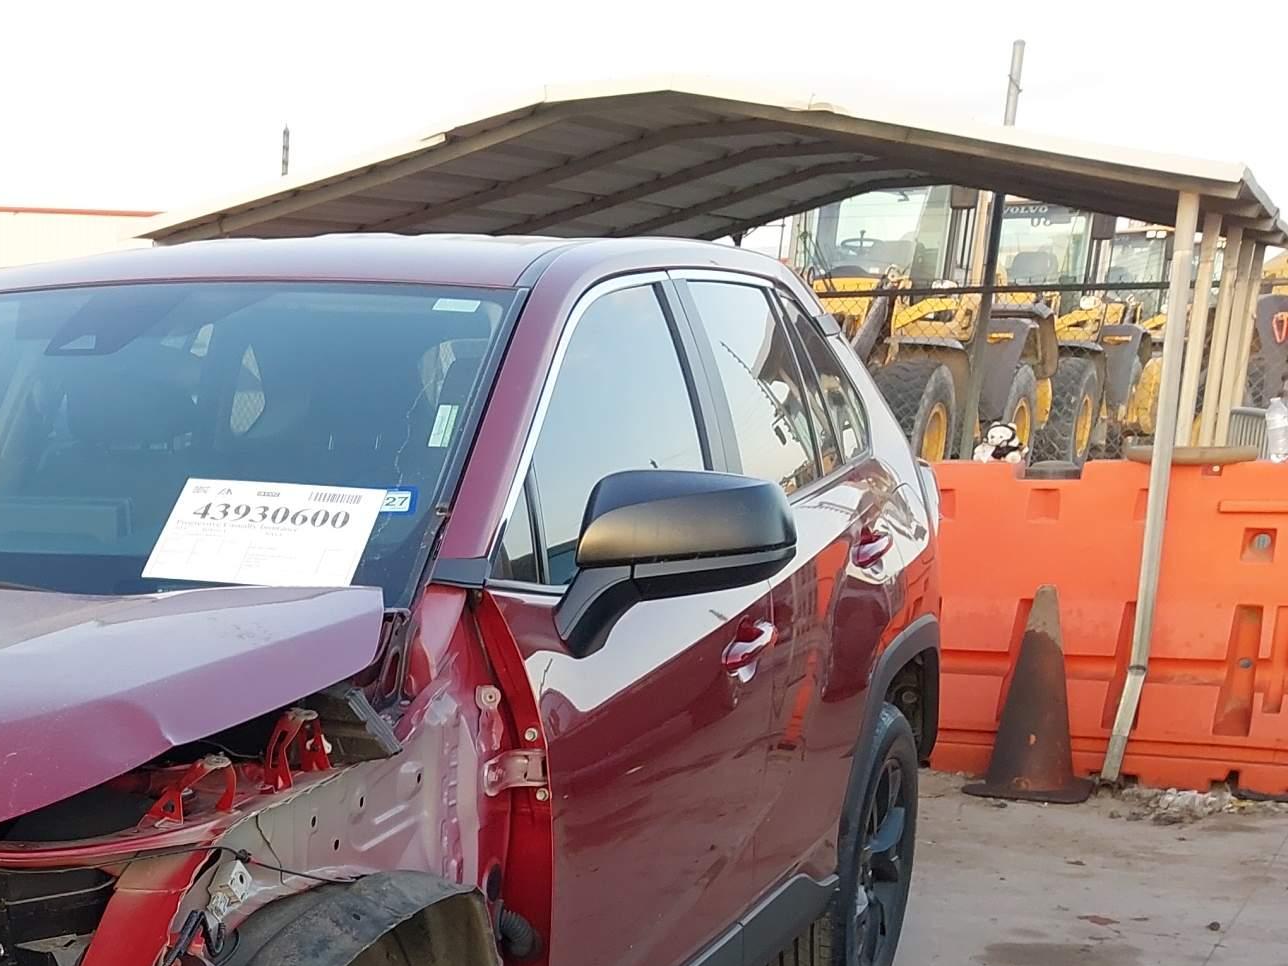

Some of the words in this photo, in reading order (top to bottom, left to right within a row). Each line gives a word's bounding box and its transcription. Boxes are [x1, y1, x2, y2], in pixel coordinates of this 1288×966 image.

[1003, 205, 1049, 214] VOLVO
[385, 496, 409, 507] 27
[192, 501, 351, 529] 43930600
